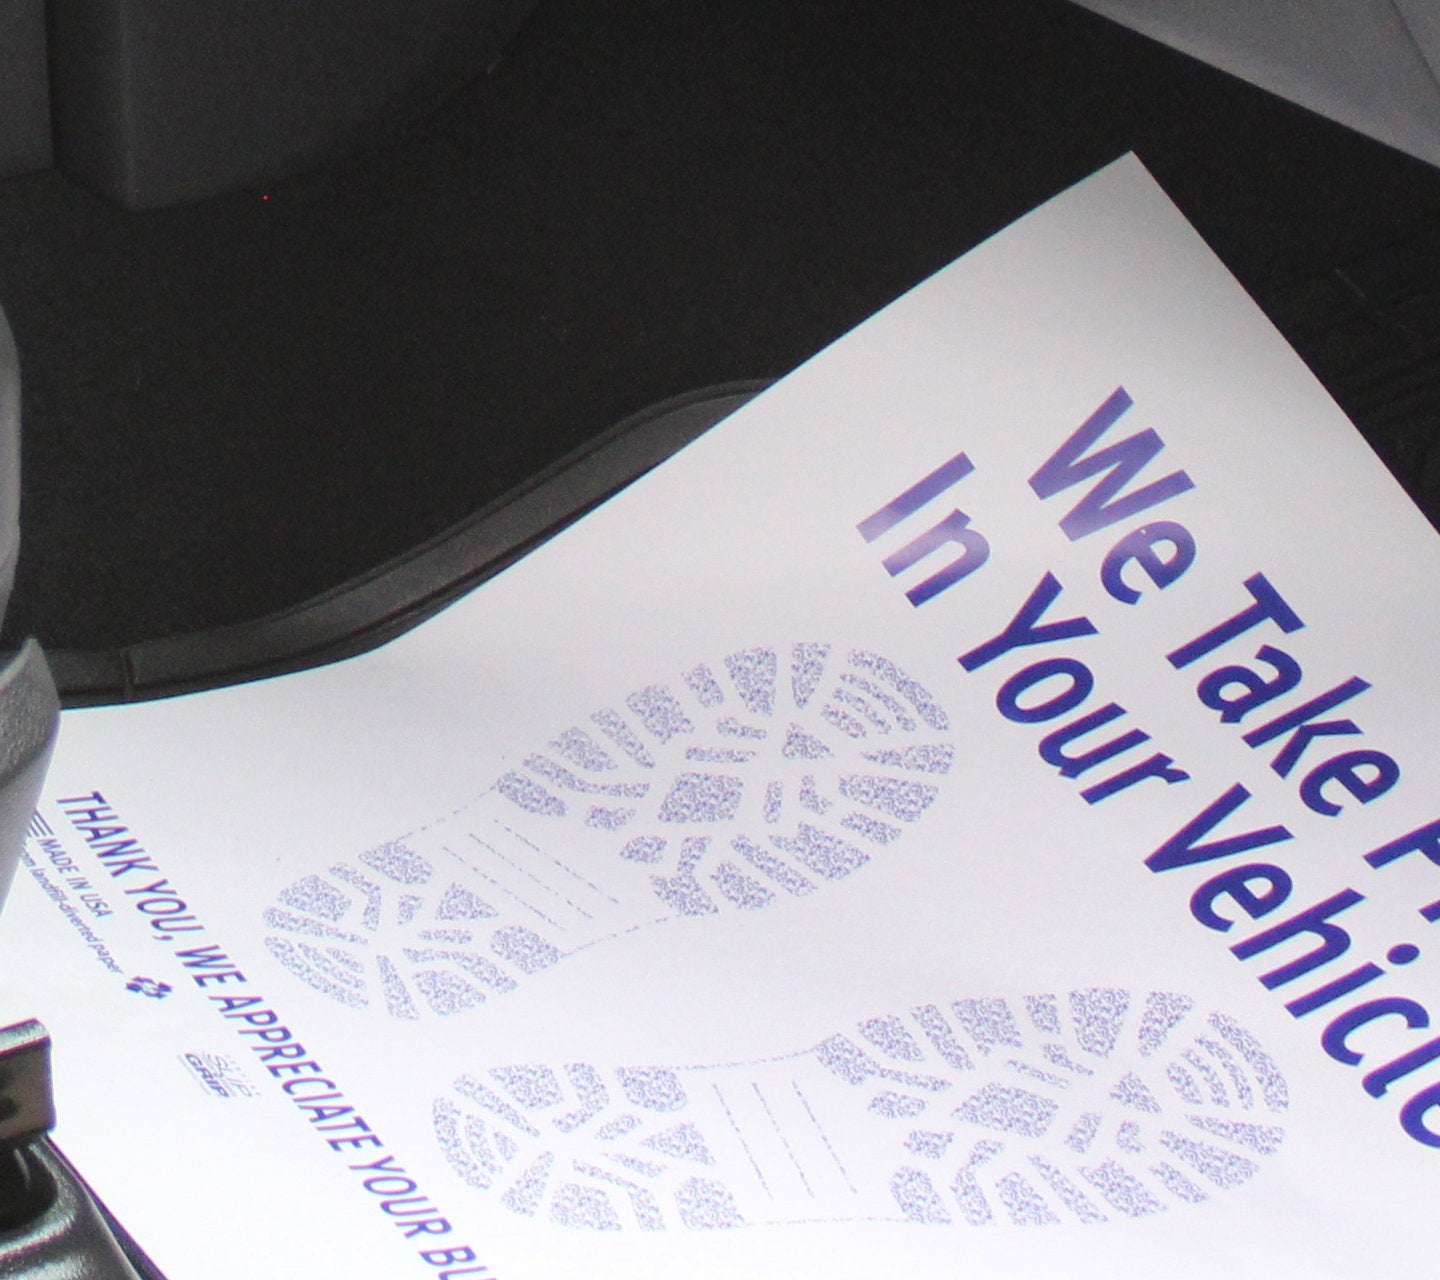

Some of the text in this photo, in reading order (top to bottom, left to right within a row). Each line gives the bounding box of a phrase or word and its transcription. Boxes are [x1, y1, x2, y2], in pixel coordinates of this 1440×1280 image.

[856, 451, 991, 608] In
[956, 570, 1192, 806] Your
[1027, 385, 1197, 606] We
[1165, 571, 1401, 818] Take
[56, 791, 160, 878] THANK
[37, 839, 114, 918] MADE IN USA
[124, 878, 206, 941] YOU,
[88, 941, 124, 974] paper
[174, 944, 248, 989] WE
[207, 995, 384, 1153] APPRECIATE
[348, 1155, 453, 1240] YOUR
